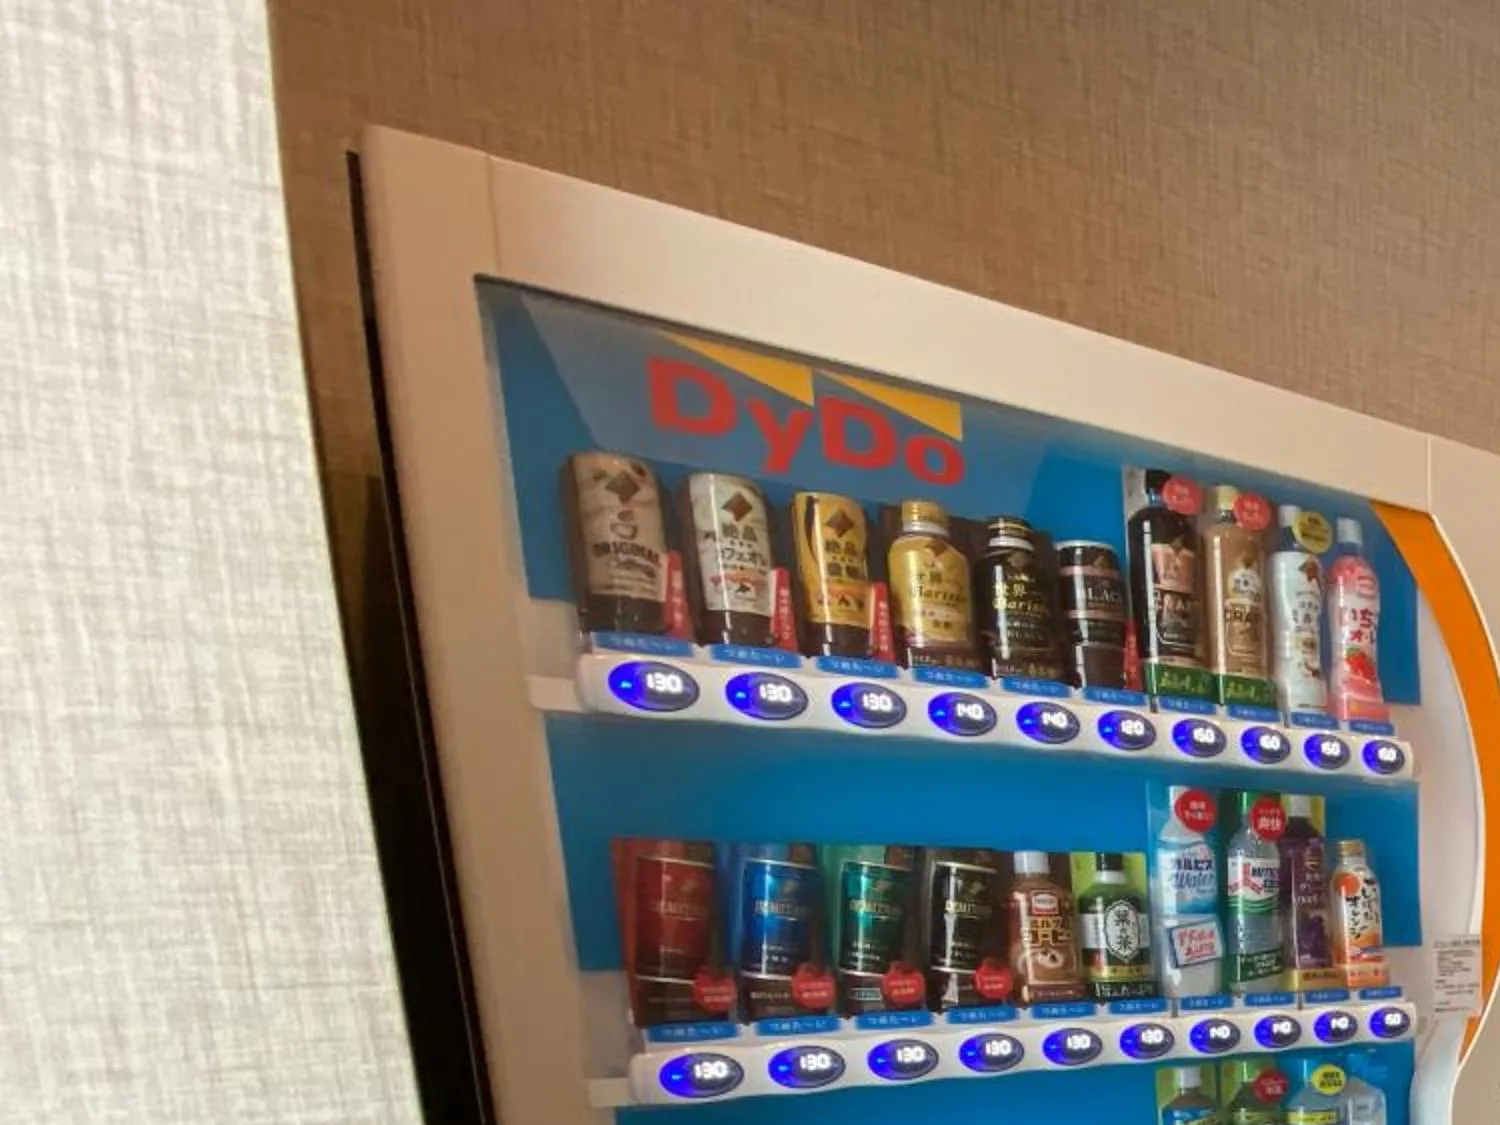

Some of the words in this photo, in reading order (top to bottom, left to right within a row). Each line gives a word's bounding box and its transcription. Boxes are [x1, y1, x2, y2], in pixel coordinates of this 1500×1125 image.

[646, 355, 965, 487] DyDo
[645, 671, 685, 694] 130
[759, 682, 794, 704] 130
[862, 692, 894, 713] 130
[896, 1045, 927, 1064] 130
[985, 1039, 1013, 1057] 130
[693, 1059, 730, 1080] 130
[799, 1052, 833, 1071] 130
